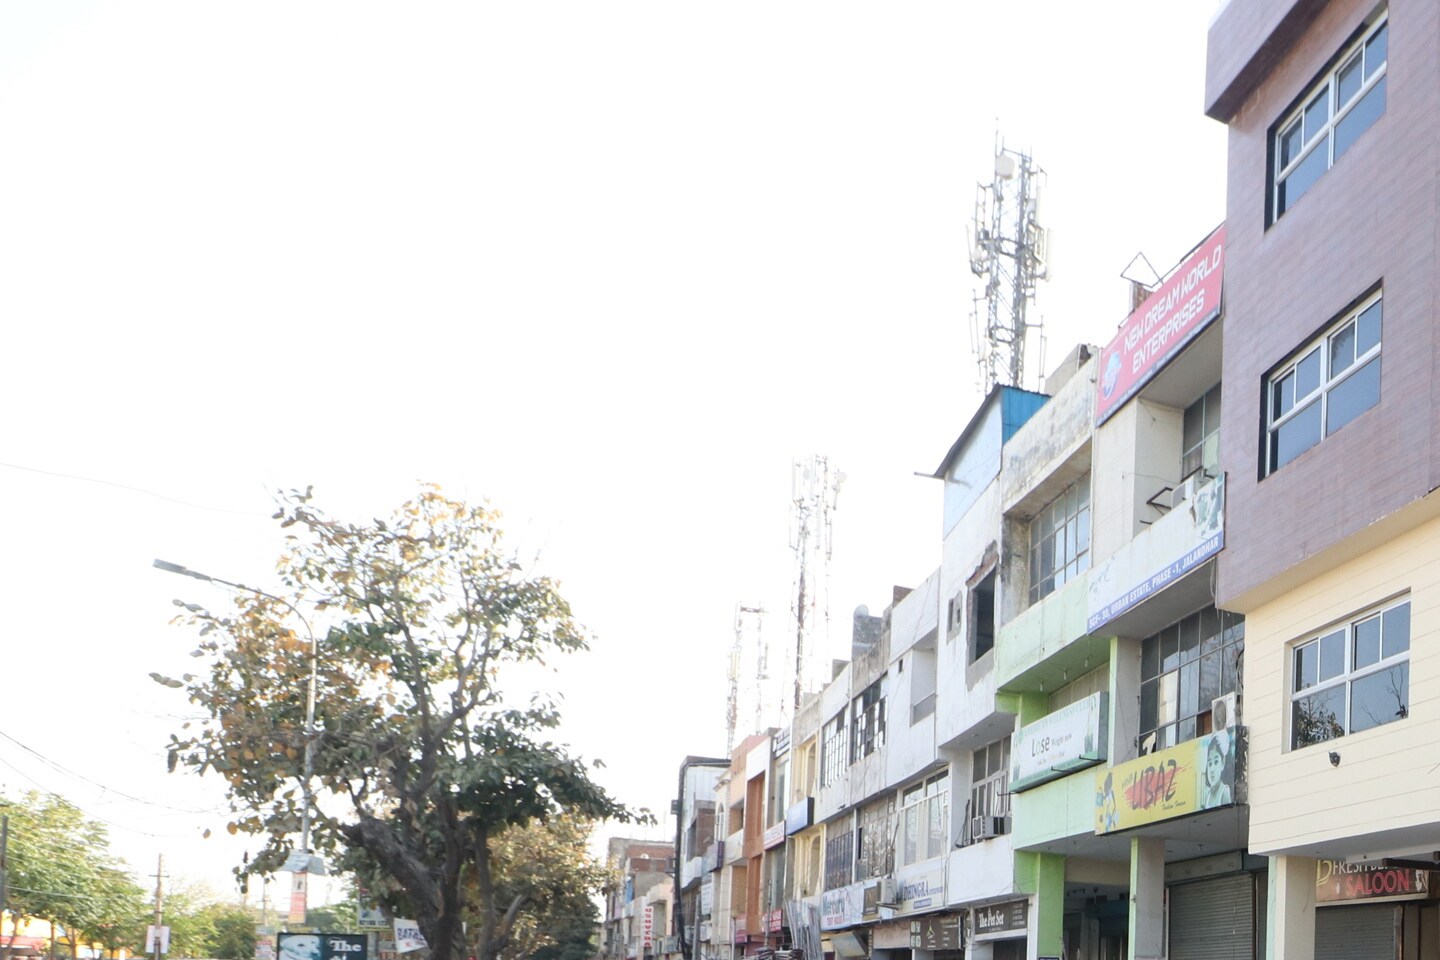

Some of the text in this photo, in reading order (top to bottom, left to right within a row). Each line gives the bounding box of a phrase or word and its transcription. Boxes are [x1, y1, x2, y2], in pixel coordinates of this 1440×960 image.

[1123, 320, 1146, 356] NEW
[1144, 288, 1181, 333] DREAM
[1179, 244, 1222, 301] WORLD
[1132, 288, 1206, 375] ENTERPRISES
[1111, 594, 1130, 615] URBAN
[1151, 568, 1172, 588] PHASE
[1182, 535, 1219, 570] JALANDHAR
[1031, 736, 1050, 757] Lose
[1132, 759, 1177, 811] LIBAZ
[1346, 869, 1410, 897] SALOON
[979, 912, 988, 928] The
[329, 940, 362, 952] The
